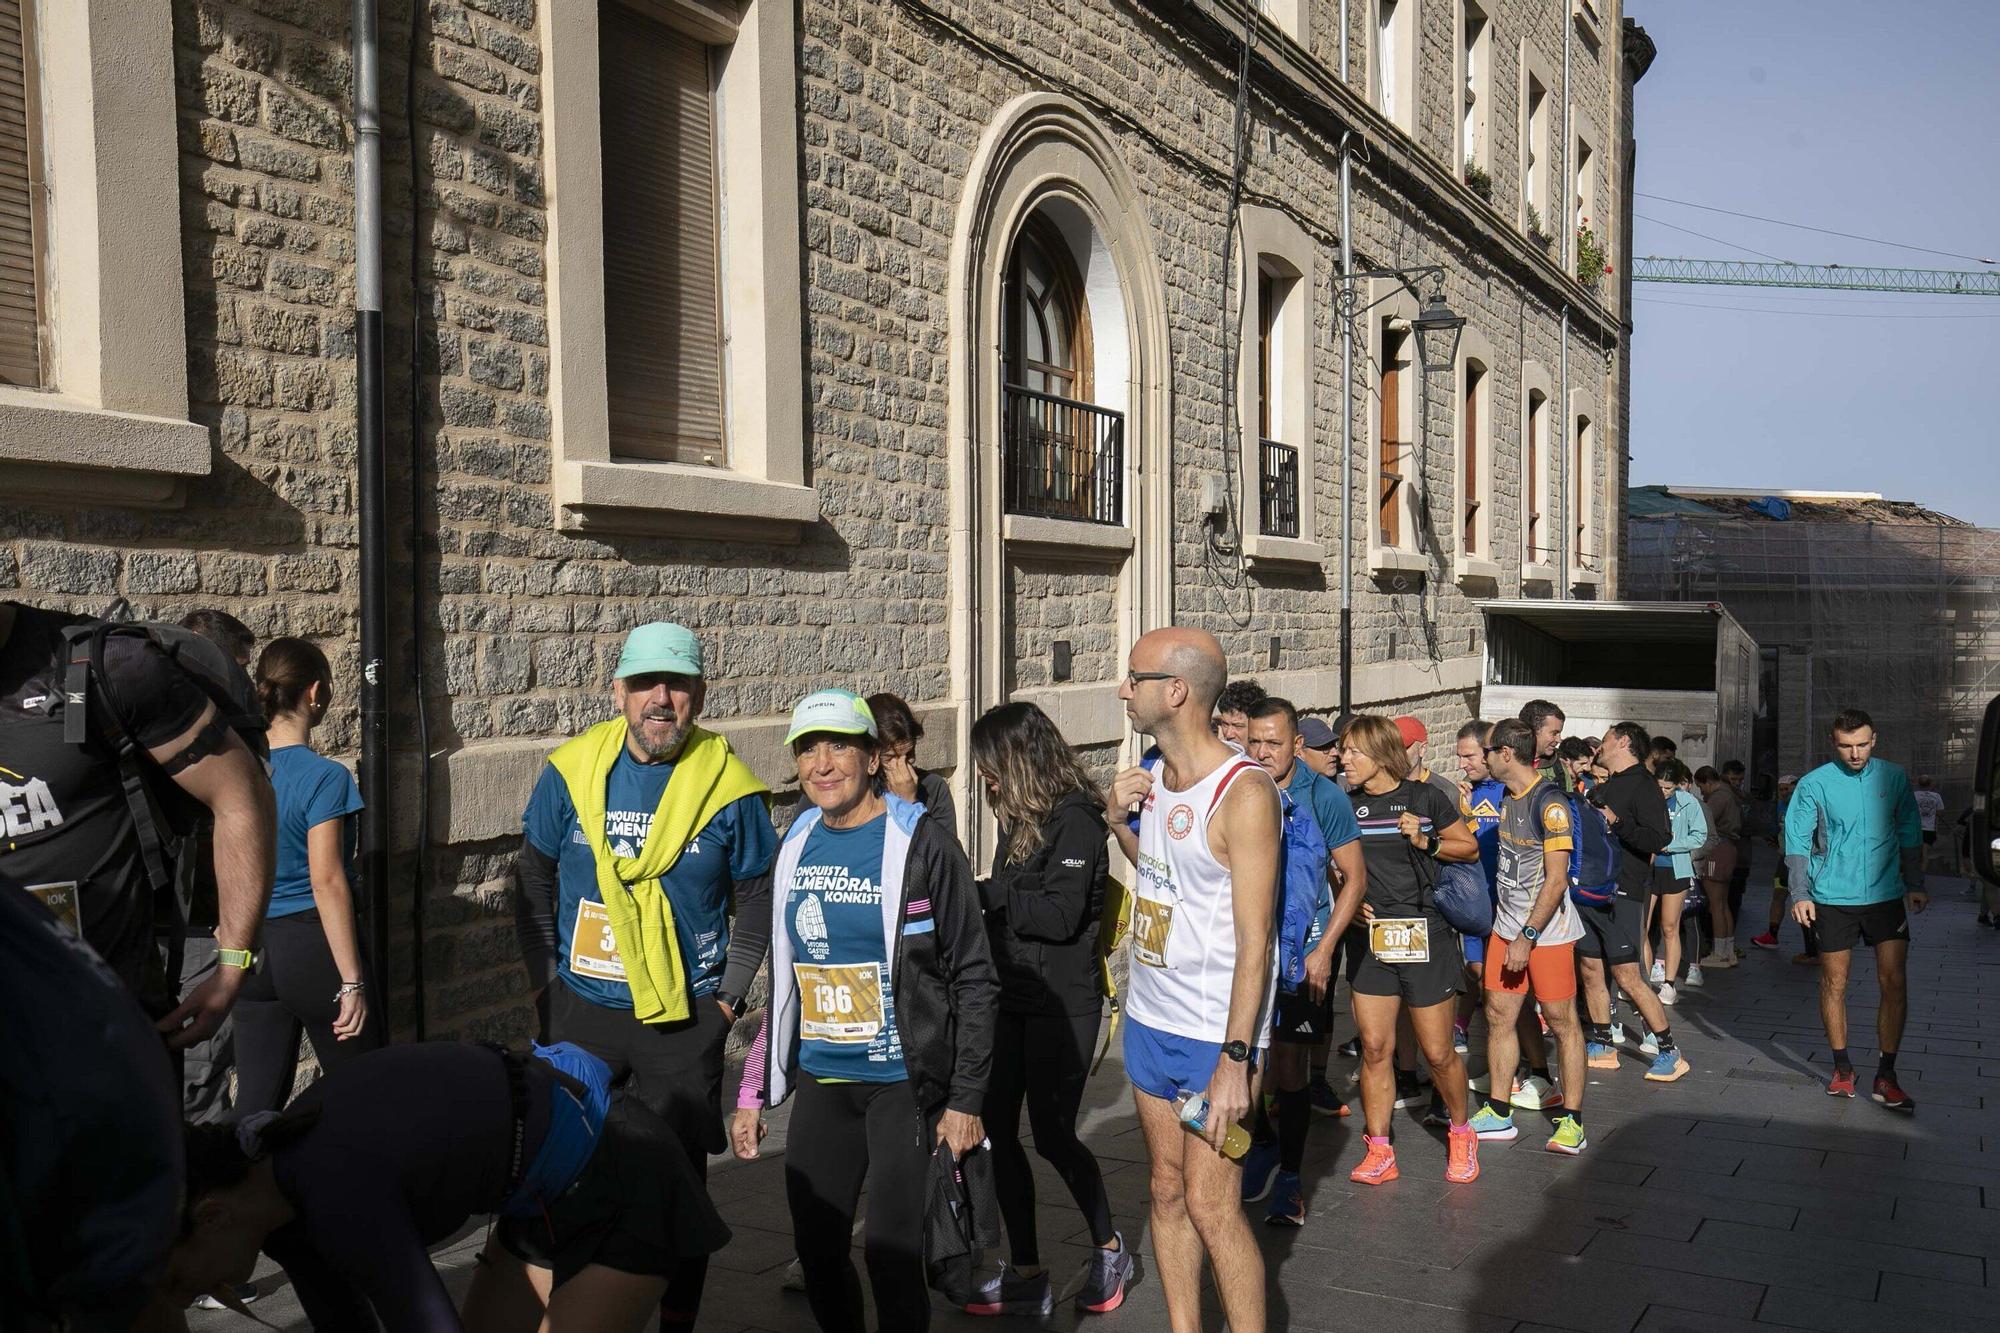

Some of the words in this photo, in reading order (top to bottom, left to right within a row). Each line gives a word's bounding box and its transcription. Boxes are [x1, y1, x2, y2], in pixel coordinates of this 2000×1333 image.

[606, 821, 654, 838] LMEN
[793, 865, 849, 878] ONQUISTA
[824, 891, 883, 905] KONKIST
[1384, 929, 1411, 946] 378
[813, 984, 853, 1014] 136
